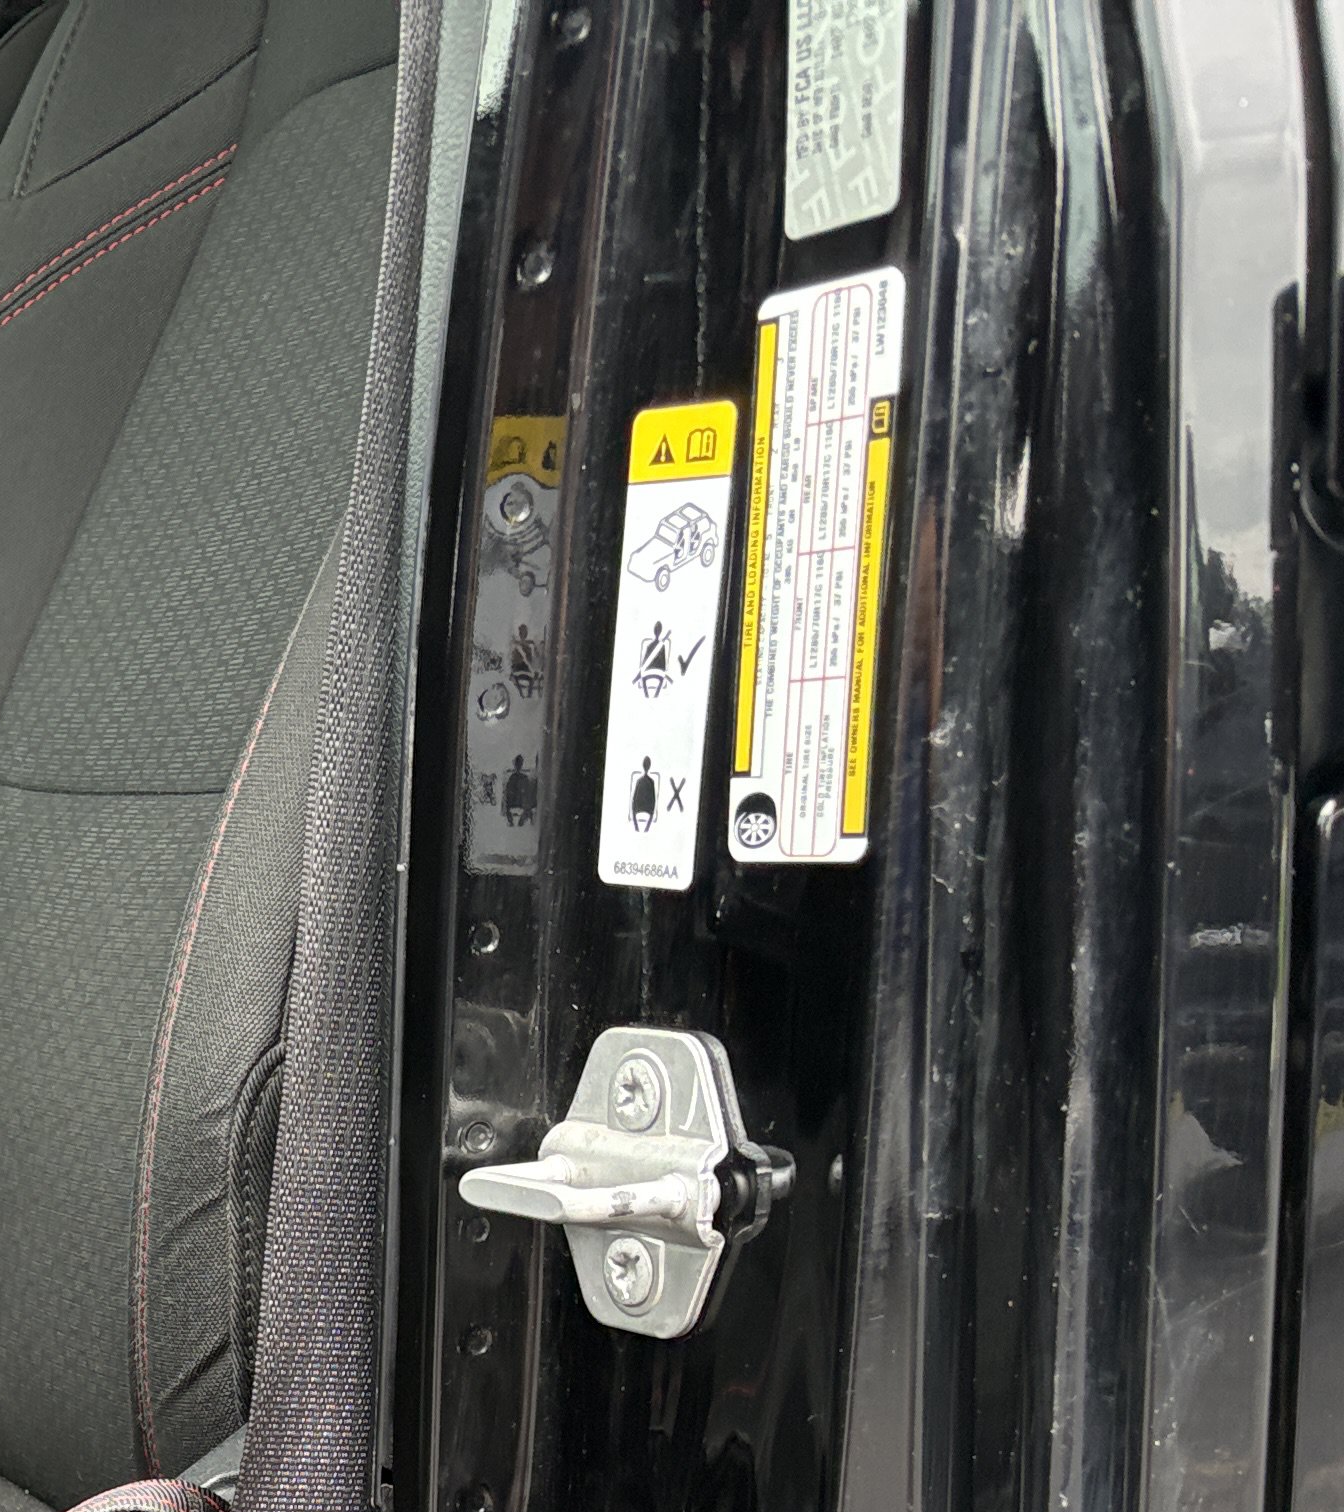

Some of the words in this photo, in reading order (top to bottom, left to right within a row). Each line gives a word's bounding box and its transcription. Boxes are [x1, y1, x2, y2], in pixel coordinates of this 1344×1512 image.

[795, 33, 812, 62] US
[793, 65, 812, 103] FCA
[788, 309, 799, 351] EXCEED
[786, 355, 796, 391] NEVER
[809, 376, 818, 411] SPARE
[782, 395, 793, 438] SHOULD
[780, 442, 790, 479] CARGO
[751, 436, 765, 525] INFORMATION
[778, 483, 787, 505] AND
[803, 474, 812, 503] REAR
[862, 480, 875, 558] INFORMATION
[747, 529, 759, 585] LOADING
[774, 509, 785, 572] OCCUPANTS
[773, 577, 781, 590] OF
[858, 561, 869, 626] ADDITIONAL
[745, 591, 755, 615] AND
[770, 595, 780, 634] WEIGHT
[794, 596, 803, 630] FRONT
[743, 621, 753, 648] TIRE
[856, 631, 865, 653] FOR
[767, 639, 777, 693] COMBINED
[853, 658, 863, 703] MANUAL
[765, 698, 773, 717] THE
[804, 724, 812, 745] SIZE
[820, 714, 830, 764] INFLATION
[849, 707, 860, 753] OWNERS
[785, 751, 793, 774] TIRE
[802, 748, 810, 769] TIRE
[825, 747, 834, 798] PRESSURE
[848, 757, 856, 776] SEE
[818, 767, 826, 788] TIRE
[799, 773, 809, 818] ORIGINAL
[816, 790, 825, 817] COLD
[613, 860, 679, 880] 68394686AA
